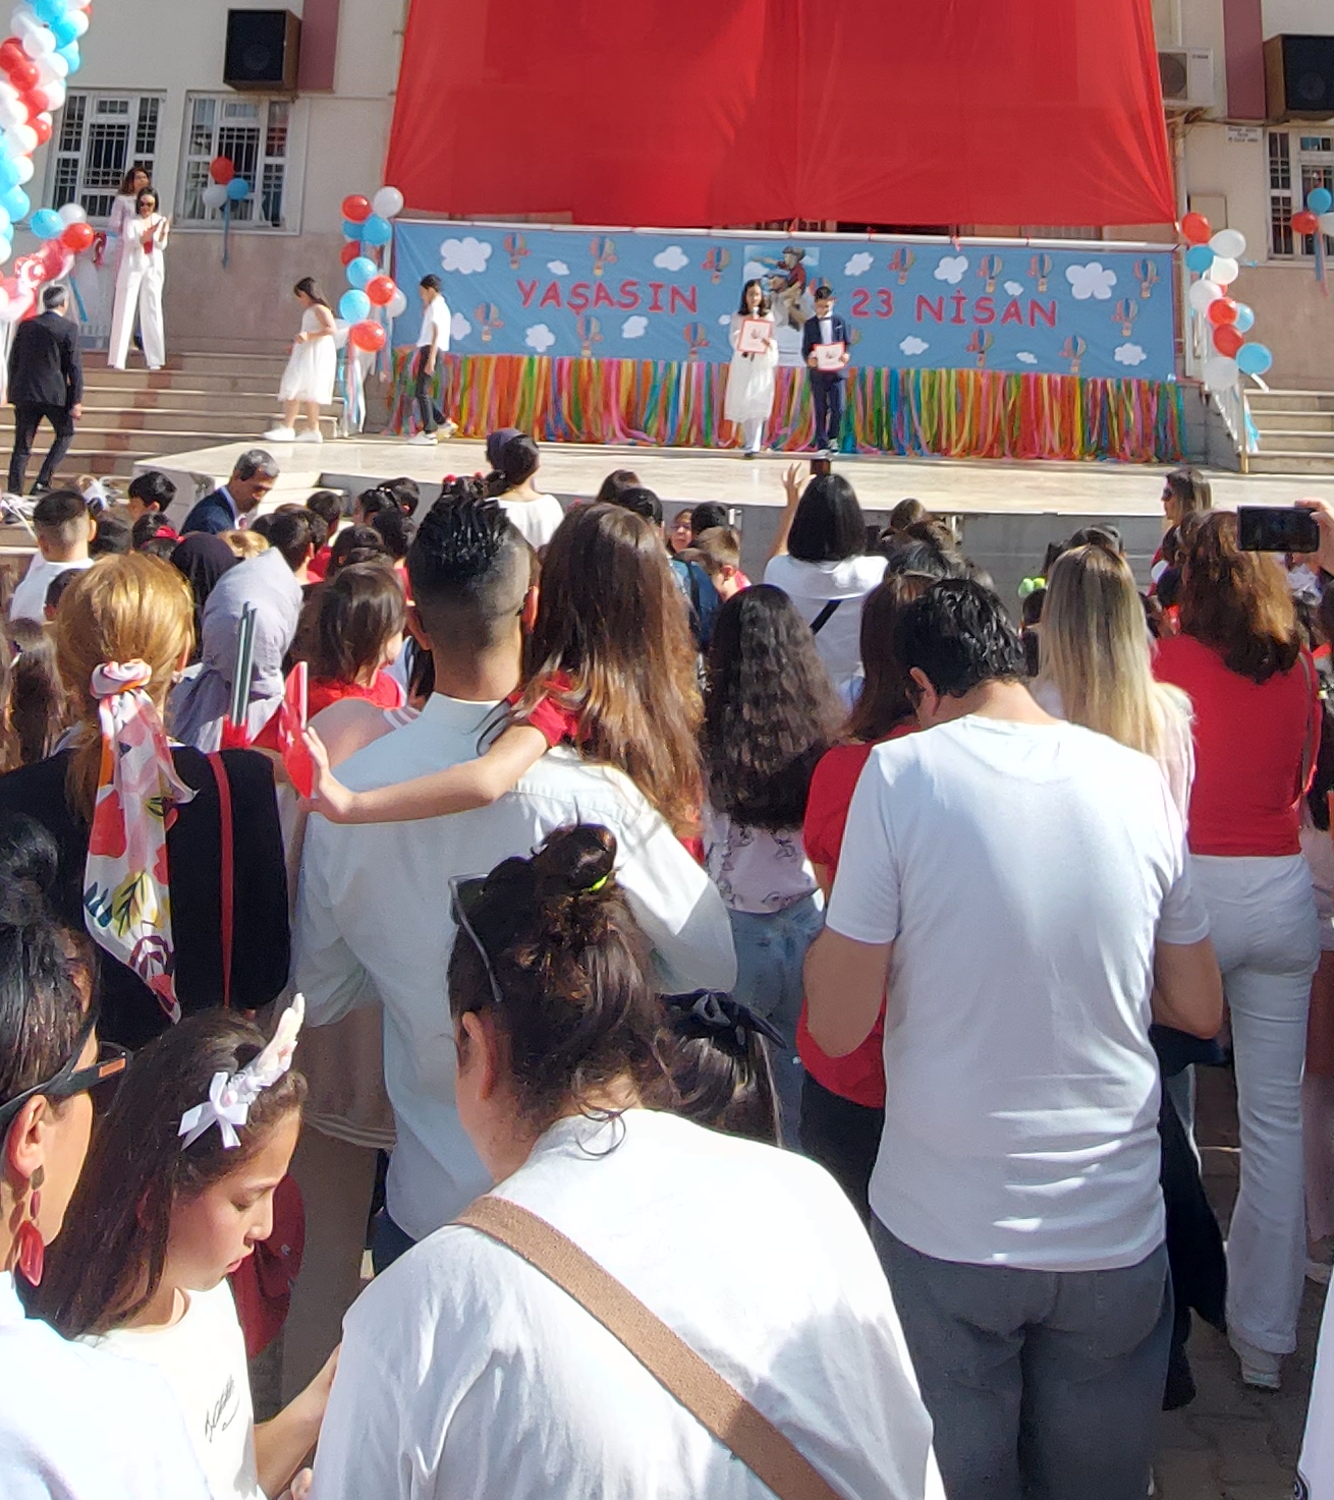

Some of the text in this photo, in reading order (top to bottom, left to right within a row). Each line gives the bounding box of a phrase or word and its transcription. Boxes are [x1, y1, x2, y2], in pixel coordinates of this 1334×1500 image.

[516, 278, 1058, 329] YAŞASIN 23 NİSAN
